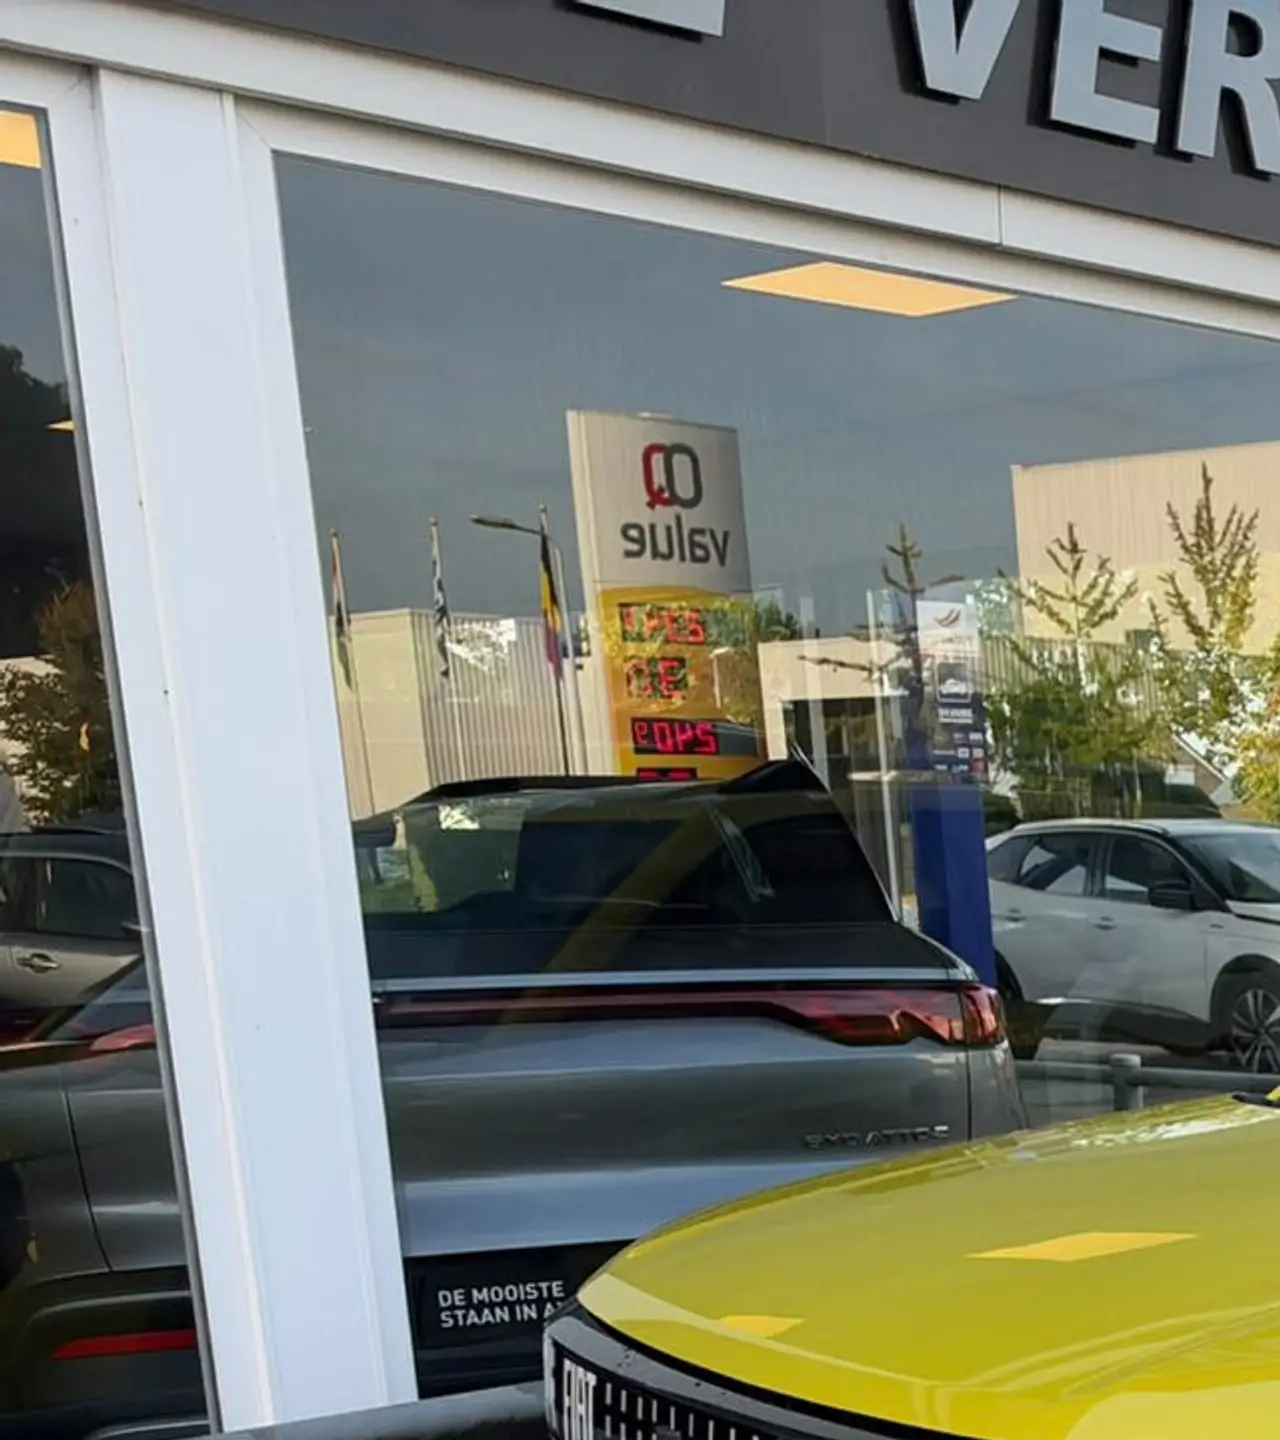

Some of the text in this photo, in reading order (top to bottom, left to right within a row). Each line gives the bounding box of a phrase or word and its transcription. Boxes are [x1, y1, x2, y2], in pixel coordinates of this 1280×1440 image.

[437, 1280, 566, 1308] DE MOOISTE
[439, 1301, 565, 1329] STAAN IN A
